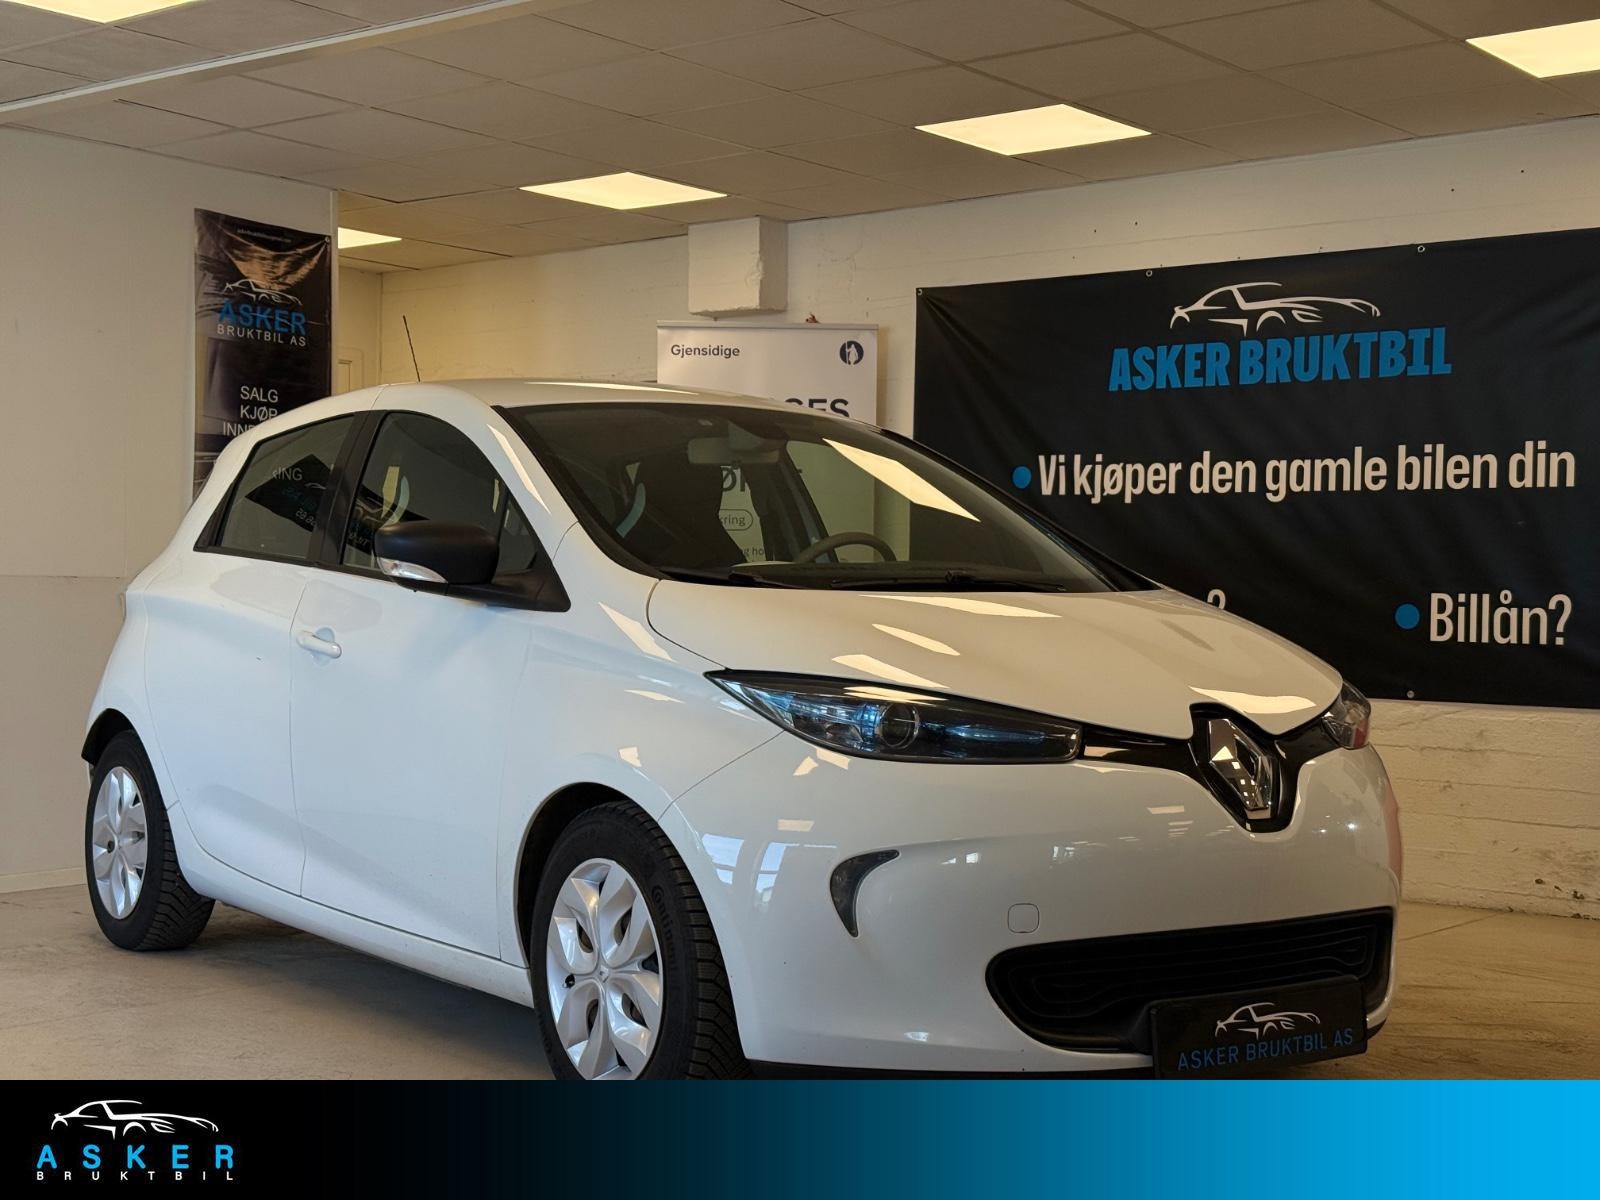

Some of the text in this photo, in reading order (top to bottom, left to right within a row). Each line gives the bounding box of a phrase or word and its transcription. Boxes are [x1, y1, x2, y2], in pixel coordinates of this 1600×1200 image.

[218, 301, 307, 335] ASKER
[217, 324, 307, 347] BRUKTBIL AS
[670, 344, 740, 359] Gjensidige
[1108, 327, 1452, 392] ASKER BRUKTBIL
[240, 385, 279, 404] SALG
[240, 404, 278, 422] KJØP
[1038, 440, 1576, 504] Vi kjøper den gamle bilen din
[1429, 590, 1573, 646] Billån?
[1177, 1028, 1354, 1071] ASKER BRUKTBIL AS
